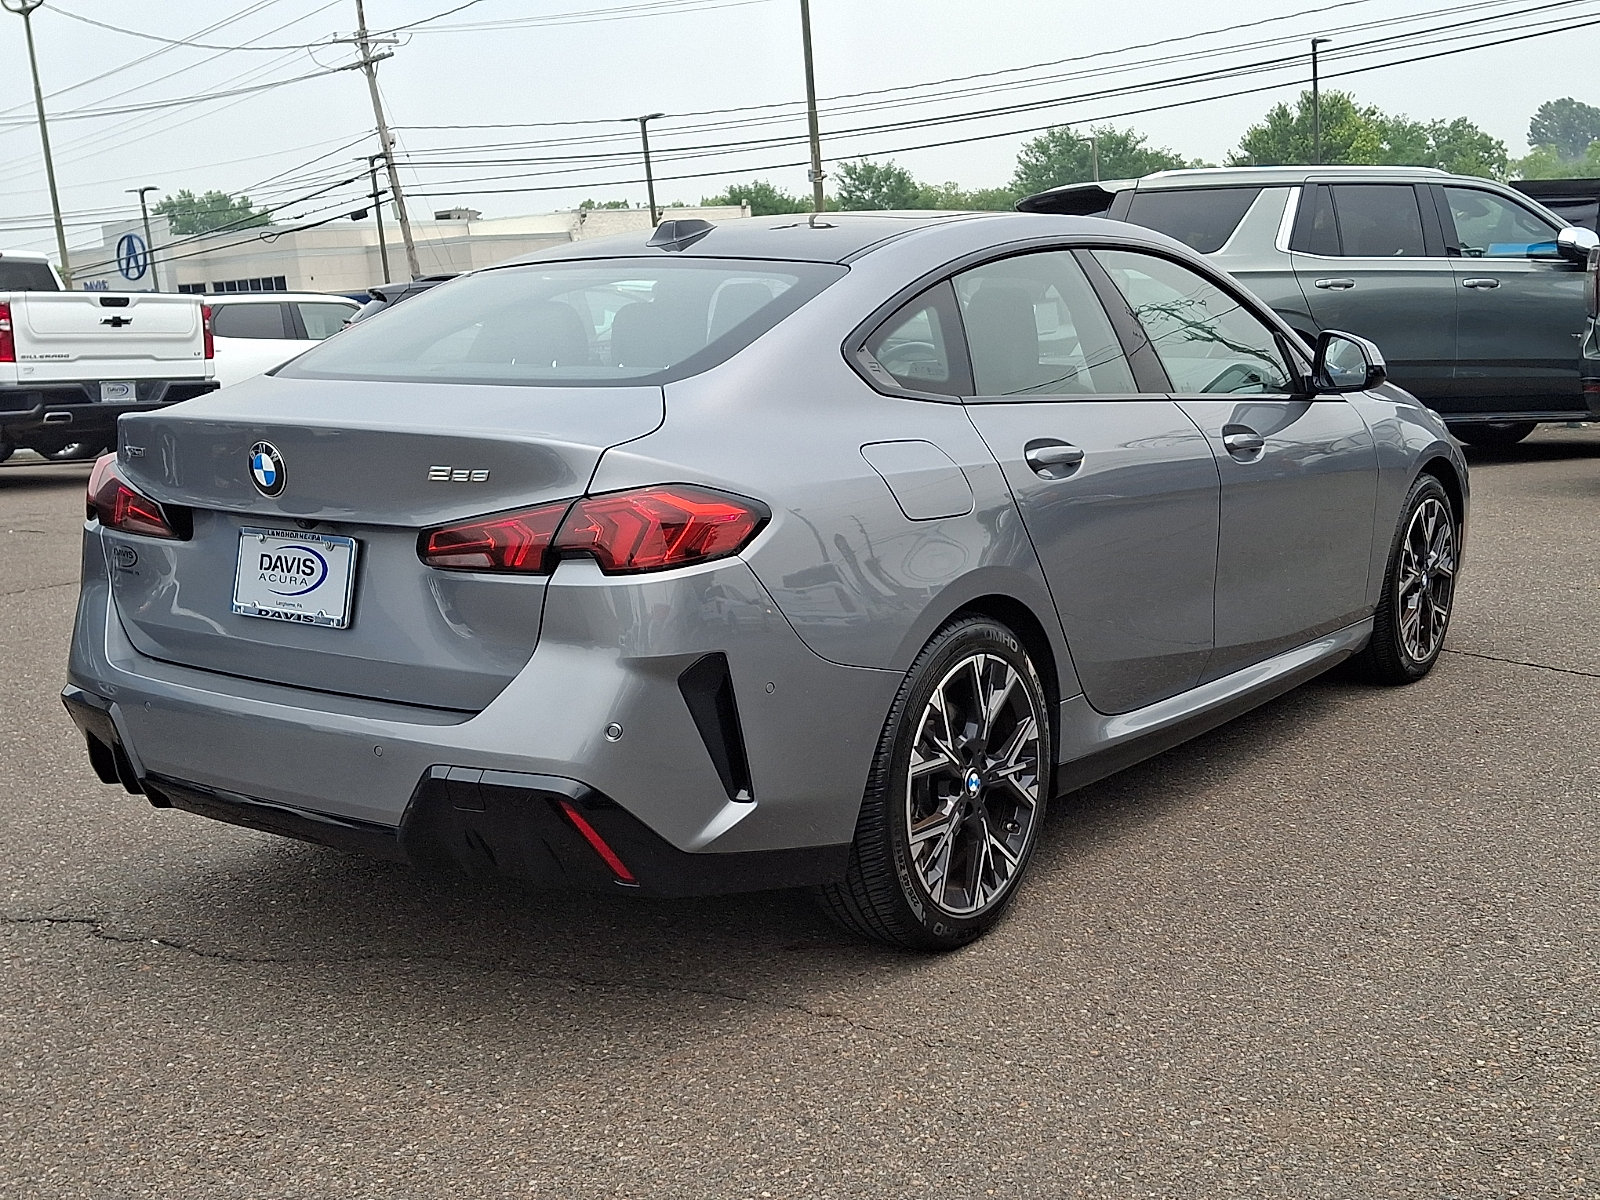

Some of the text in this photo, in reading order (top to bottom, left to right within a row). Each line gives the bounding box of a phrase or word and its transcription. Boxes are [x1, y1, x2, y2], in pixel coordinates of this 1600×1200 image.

[83, 279, 109, 291] DAVIS
[259, 553, 315, 577] DAVIS
[258, 572, 308, 586] ACURA
[258, 608, 315, 623] DAVIS
